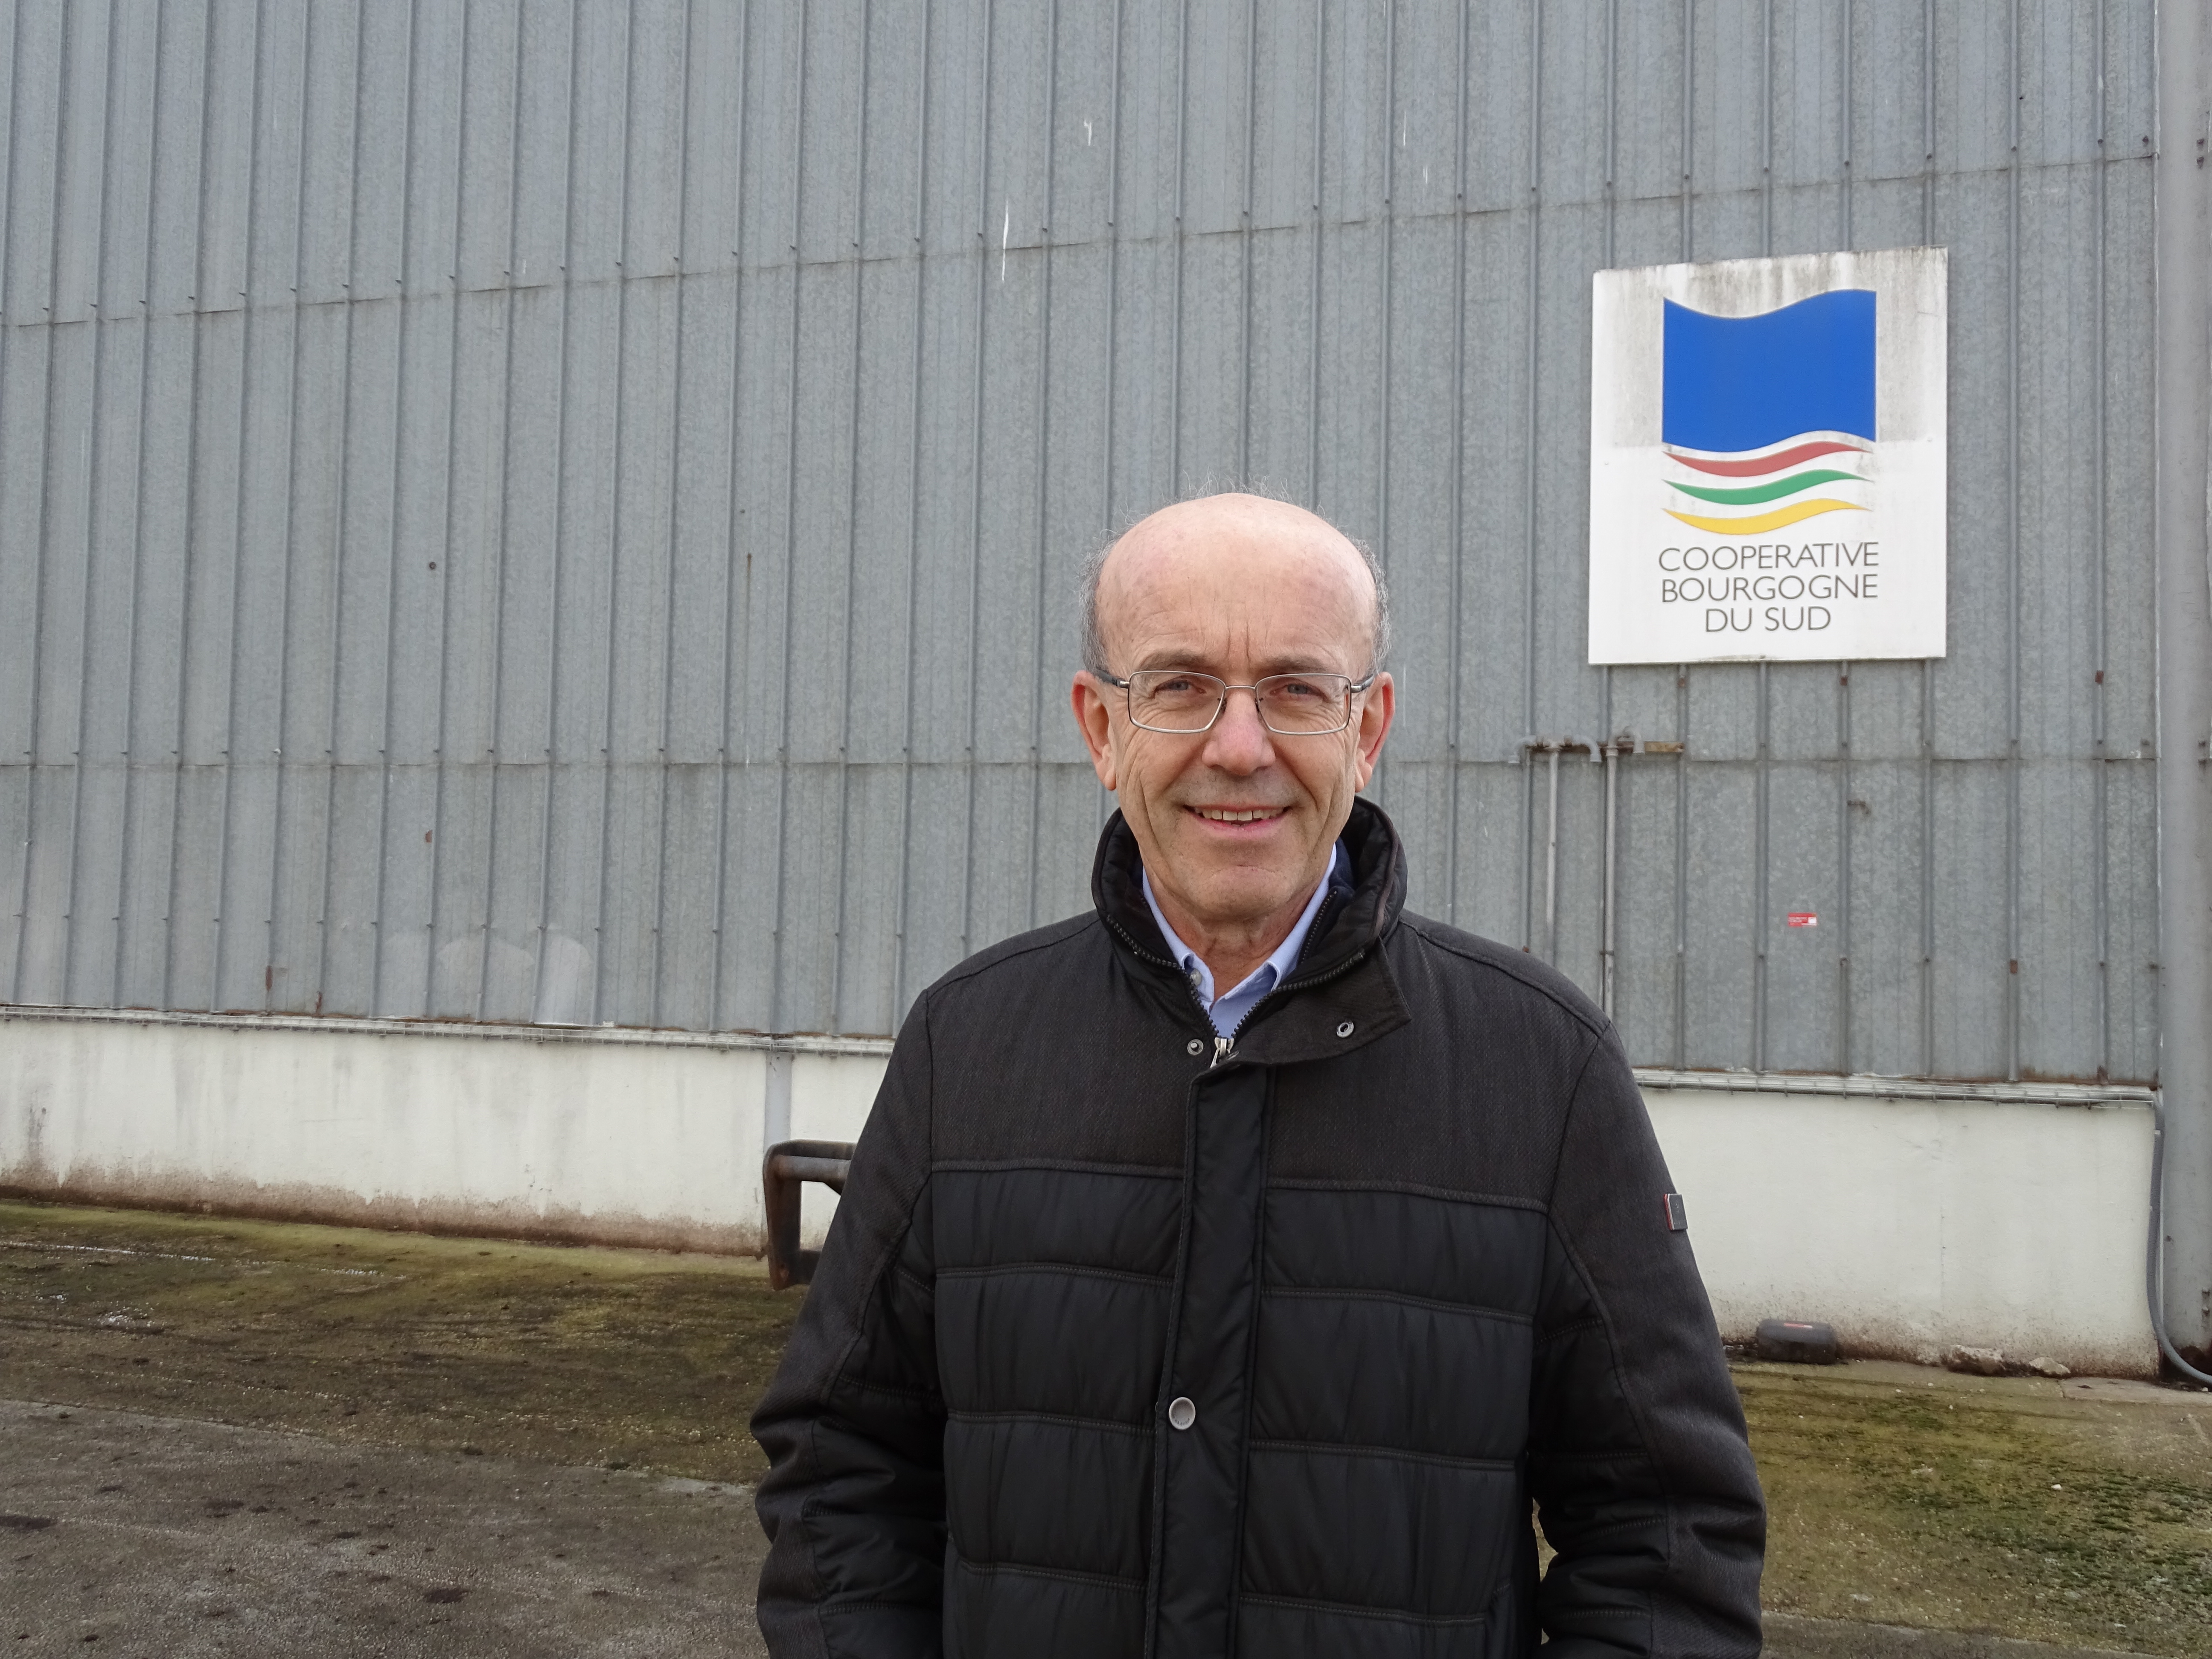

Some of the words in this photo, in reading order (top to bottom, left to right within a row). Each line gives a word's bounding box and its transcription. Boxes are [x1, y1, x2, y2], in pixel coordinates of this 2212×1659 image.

[1659, 541, 1879, 571] COOPERATIVE
[1662, 573, 1878, 603] BOURGOGNE
[1706, 608, 1752, 632] DU
[1765, 606, 1831, 632] SUD
